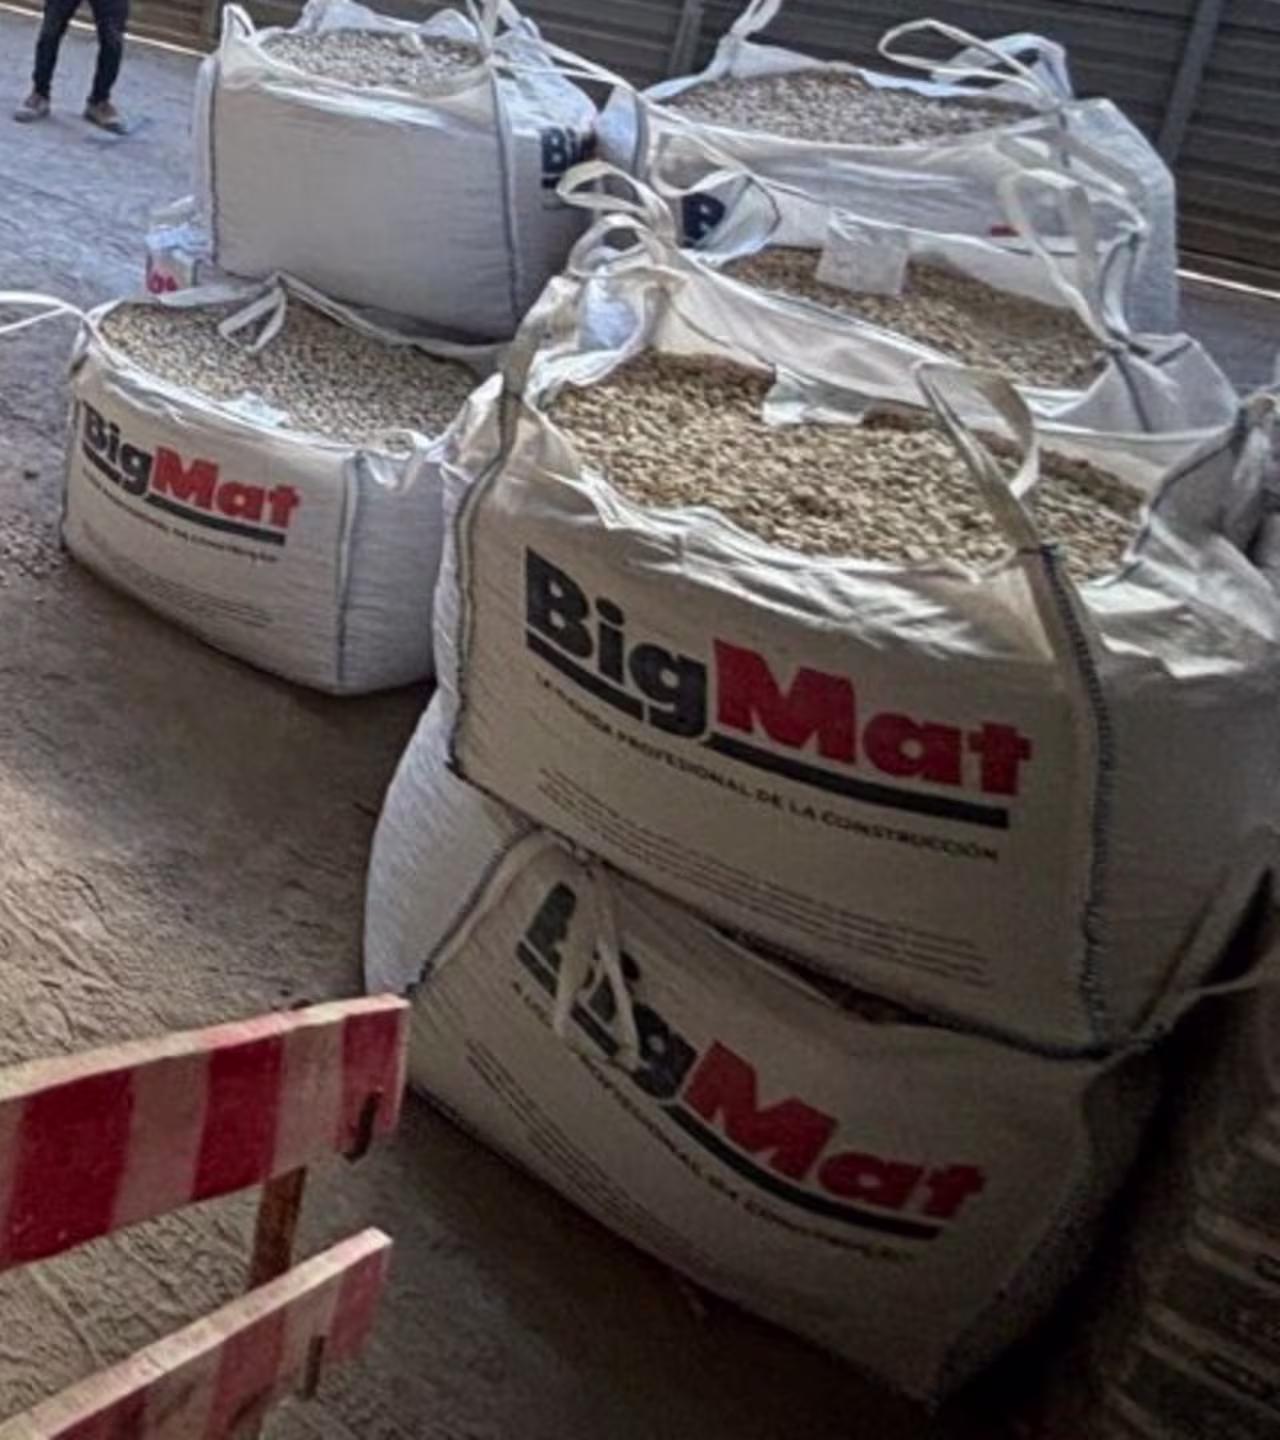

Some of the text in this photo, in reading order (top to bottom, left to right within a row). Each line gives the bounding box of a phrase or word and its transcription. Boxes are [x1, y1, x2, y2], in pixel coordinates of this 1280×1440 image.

[82, 400, 301, 529] BigMat
[526, 545, 1032, 796] BigMat
[616, 730, 751, 797] PROFESIONAL
[756, 787, 785, 810] DE
[789, 800, 818, 822] LA
